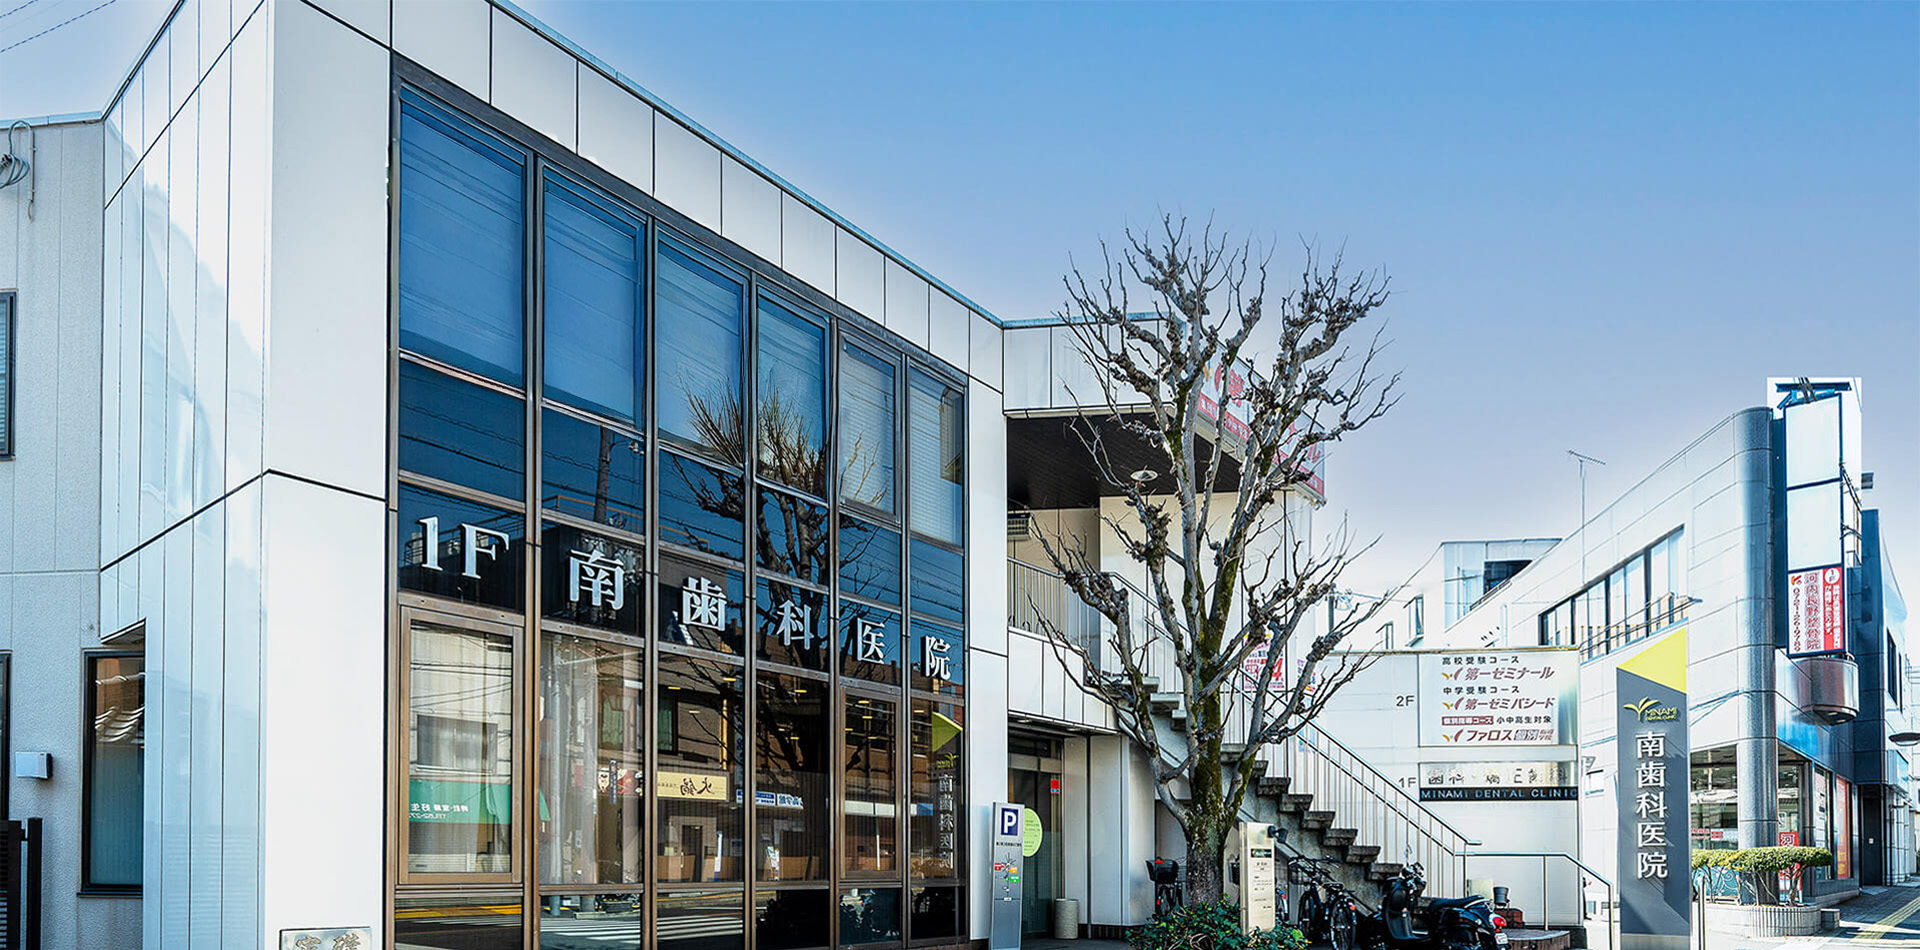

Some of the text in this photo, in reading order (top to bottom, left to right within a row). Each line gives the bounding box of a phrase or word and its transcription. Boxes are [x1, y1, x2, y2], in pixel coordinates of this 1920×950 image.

[419, 516, 952, 681] 1F 南歯科医院
[1804, 572, 1821, 650] 河内長野整骨院
[1442, 655, 1520, 666] 高校受験コース
[1464, 666, 1555, 681] 第一ゼミナール
[1443, 685, 1520, 695] 中学受験コース
[1396, 696, 1415, 707] 2F
[1645, 707, 1677, 716] MINAMI
[1496, 716, 1552, 724] 小中高生対象
[1466, 730, 1513, 742] ファロス
[1399, 778, 1417, 788] 1F
[1421, 788, 1577, 798] MINAMI DENTAL CLINIC
[1635, 731, 1668, 880] 南歯科医院
[1003, 811, 1017, 833] P
